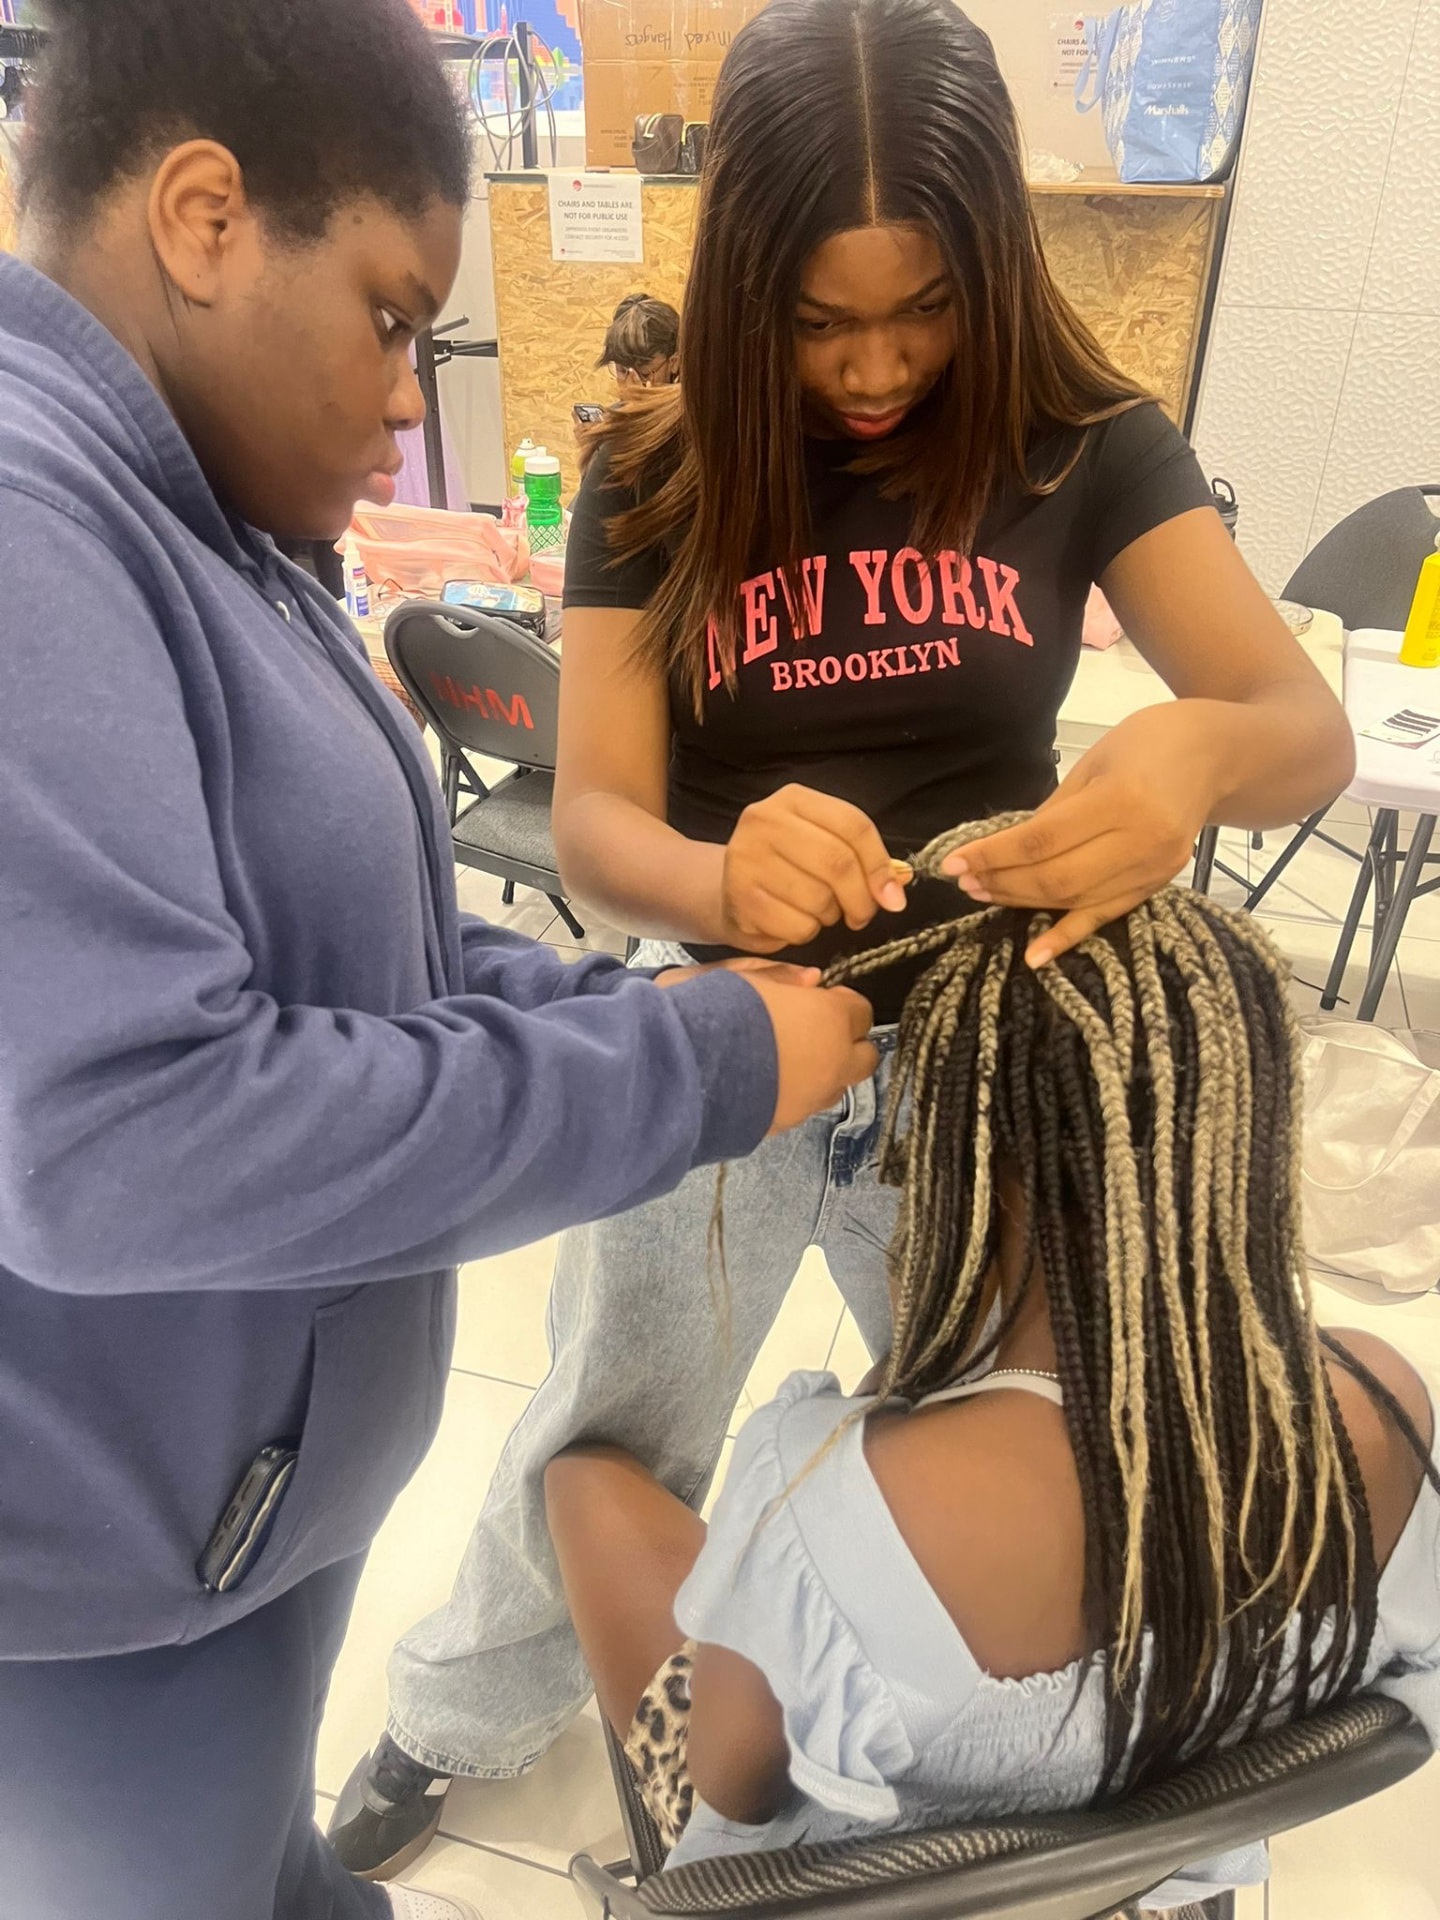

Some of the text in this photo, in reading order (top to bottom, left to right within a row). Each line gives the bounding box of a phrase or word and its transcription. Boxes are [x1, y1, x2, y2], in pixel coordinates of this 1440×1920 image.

[624, 24, 672, 51] Hangers
[1057, 38, 1080, 46] CHAIRS
[1143, 103, 1189, 116] Marshalls
[558, 200, 633, 209] CHAIRS AND TABLES ARE
[563, 212, 628, 221] NOT FOR PUBLIC USE
[849, 546, 1034, 648] YORK
[770, 636, 961, 692] BROOKLYN
